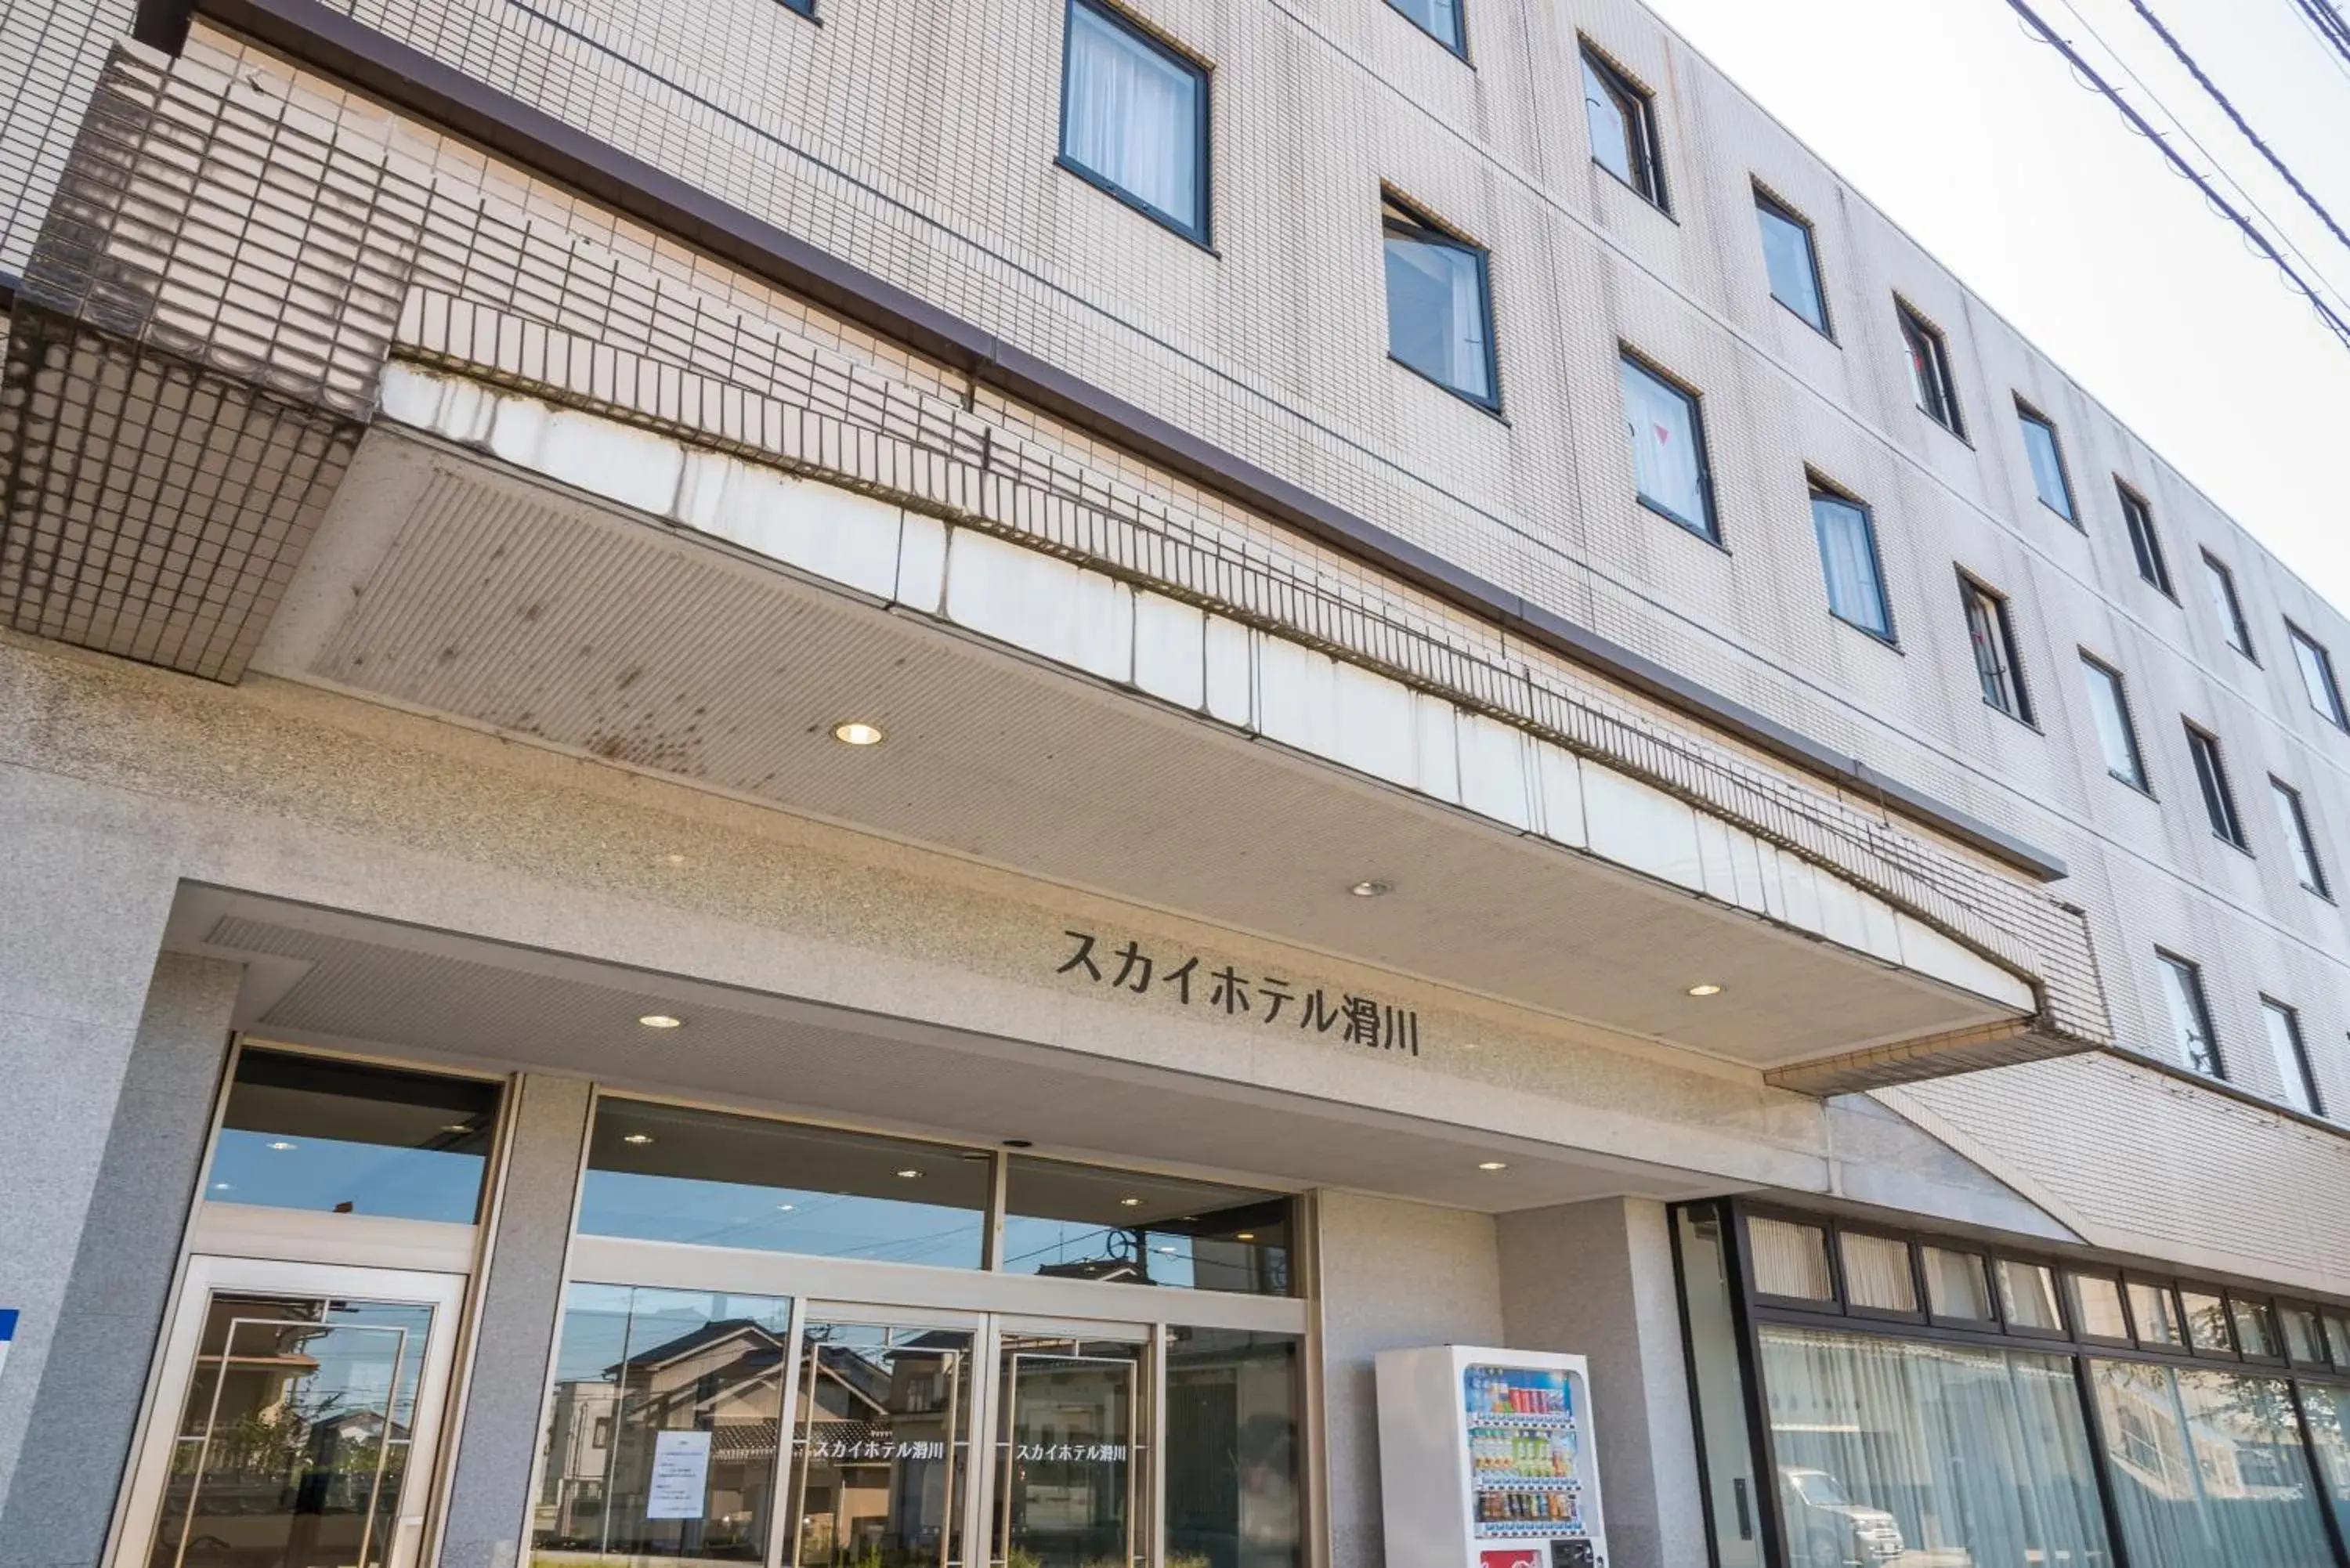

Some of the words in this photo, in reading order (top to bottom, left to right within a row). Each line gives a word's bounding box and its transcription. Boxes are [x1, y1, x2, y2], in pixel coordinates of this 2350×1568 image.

[1057, 930, 1419, 1056] スカイホテル滑川
[815, 1440, 945, 1459] スカイホテル滑川
